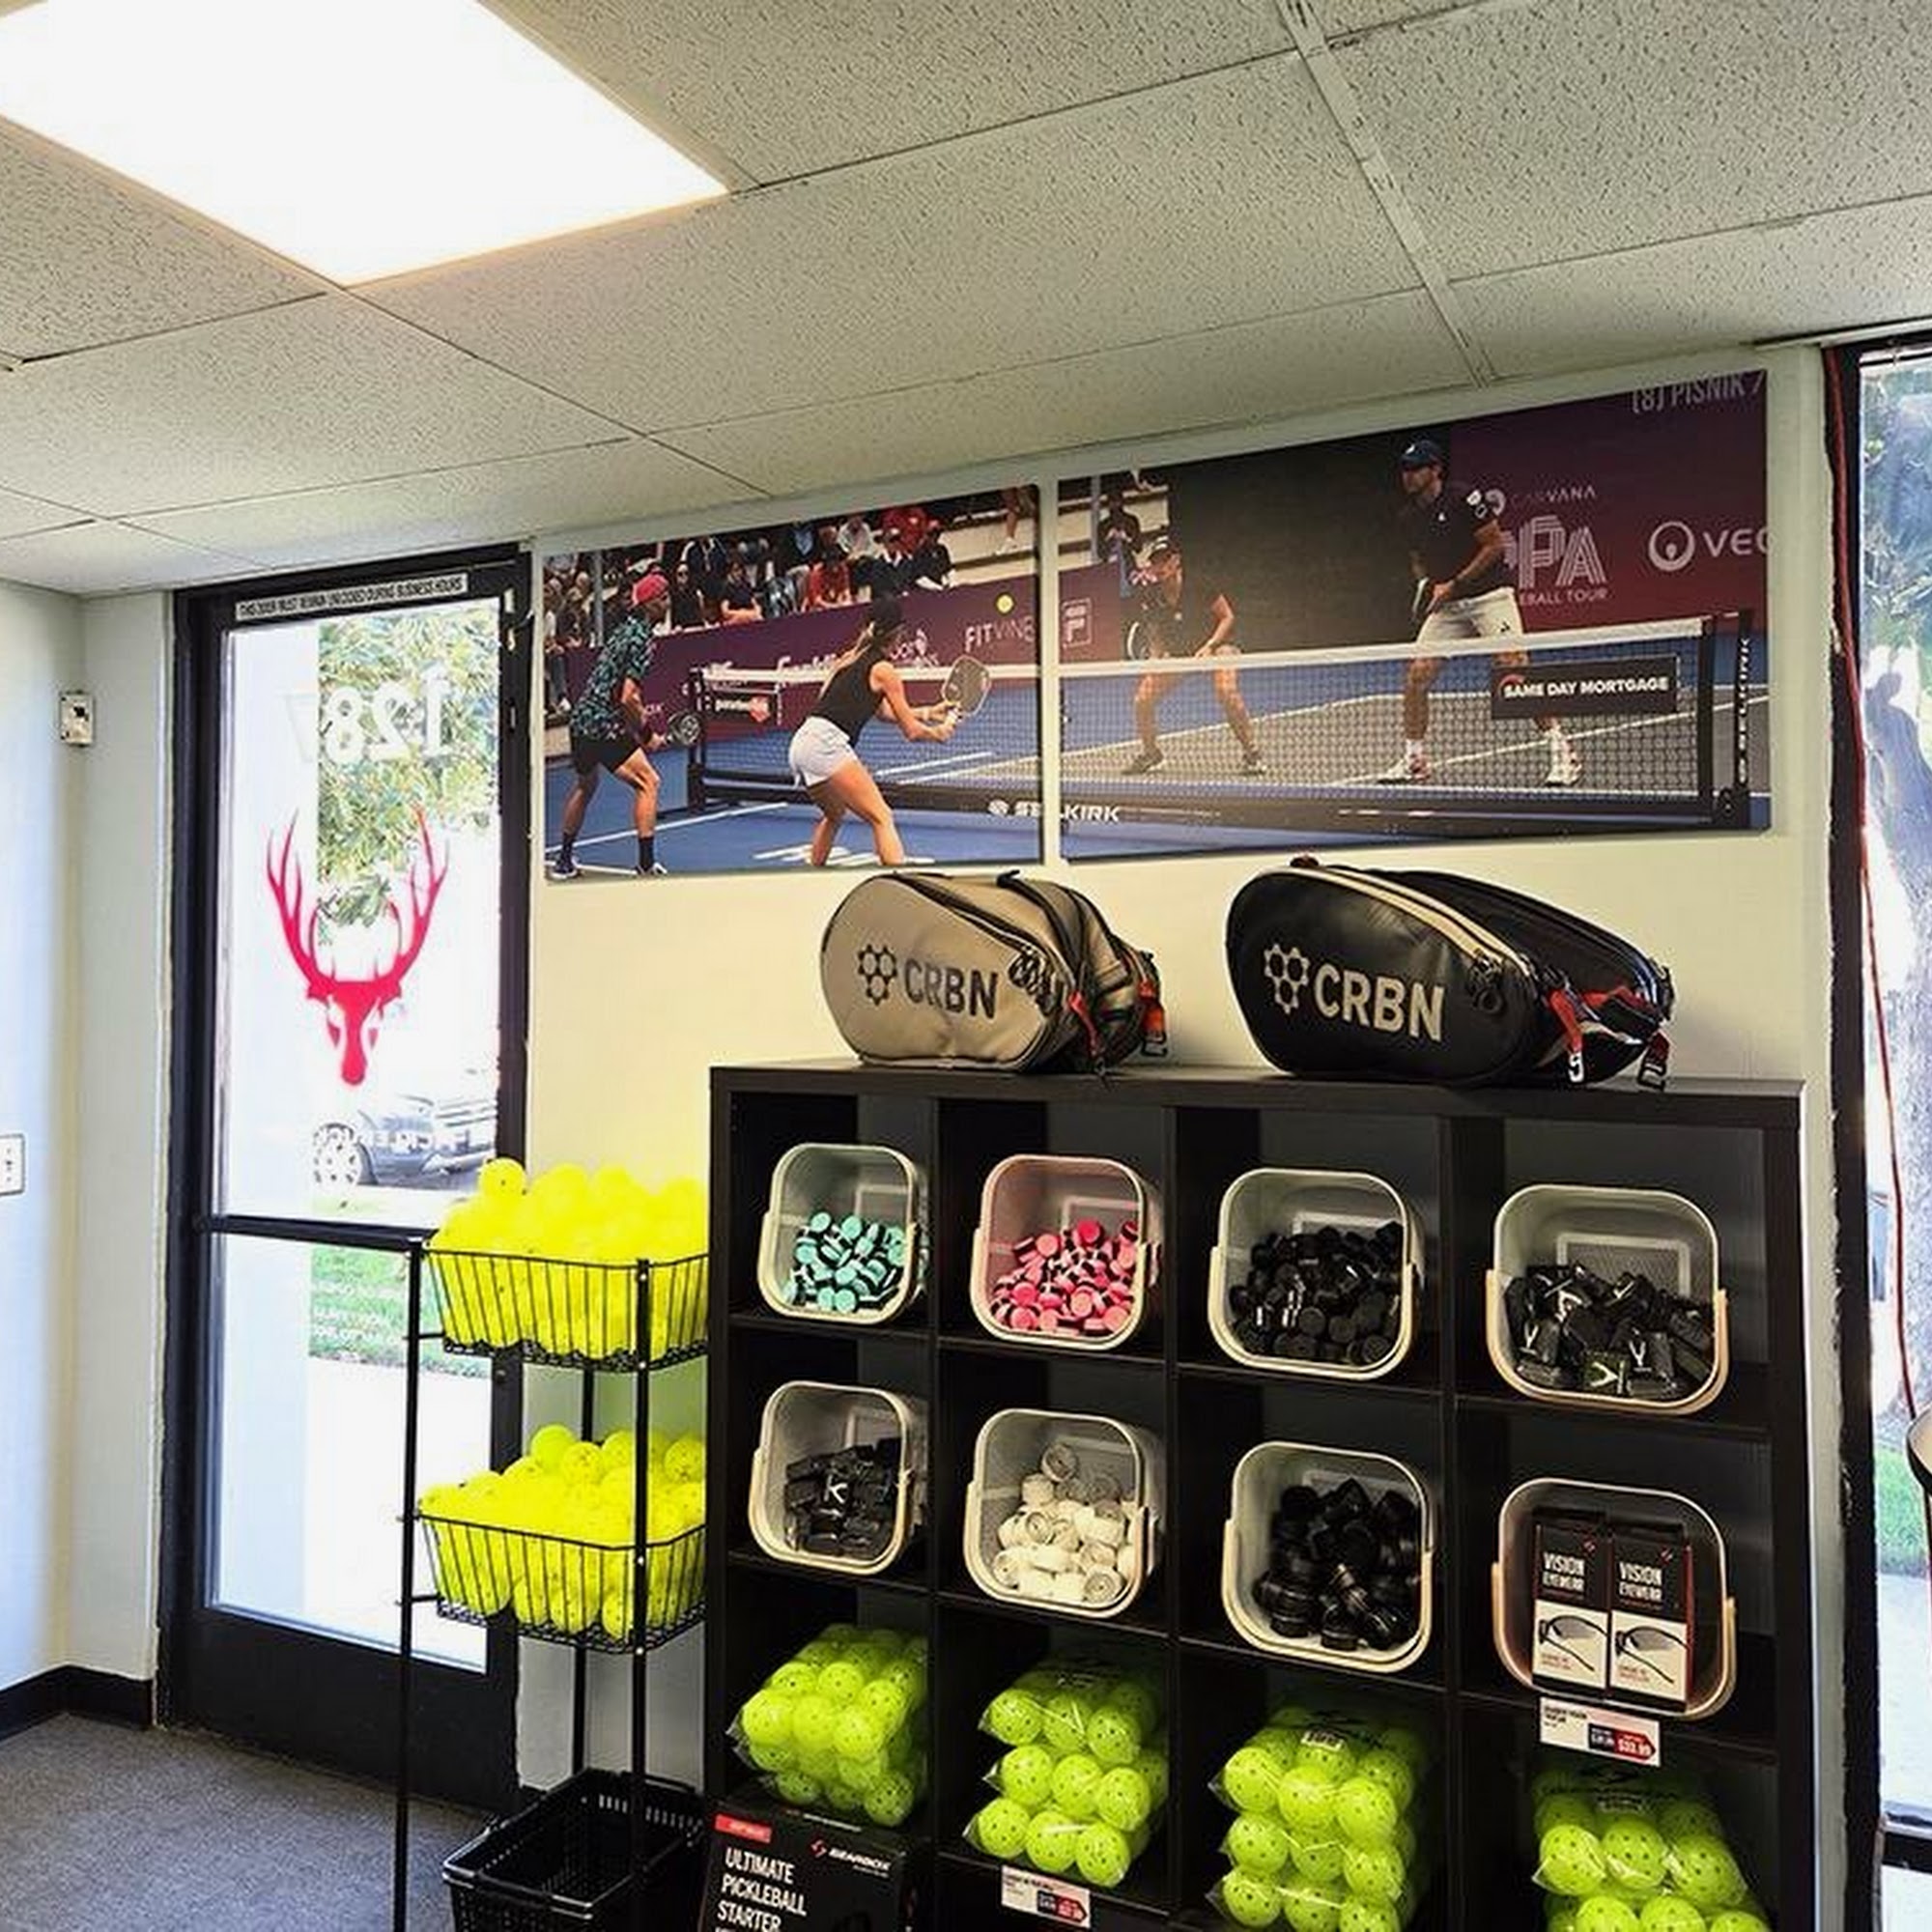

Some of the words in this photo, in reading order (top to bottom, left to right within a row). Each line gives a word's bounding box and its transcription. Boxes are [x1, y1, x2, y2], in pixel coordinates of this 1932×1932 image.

[1503, 683, 1545, 698] SAME
[1548, 681, 1577, 696] DAY
[1580, 677, 1669, 695] MORTGAGE
[903, 958, 999, 1019] CRBN
[1314, 963, 1445, 1042] CRBN
[1543, 1551, 1585, 1577] VISION
[1619, 1561, 1662, 1586] VISION
[724, 1846, 795, 1885] ULTIMATE
[721, 1873, 808, 1918] PICKLEBALL
[717, 1899, 782, 1932] STARTER
